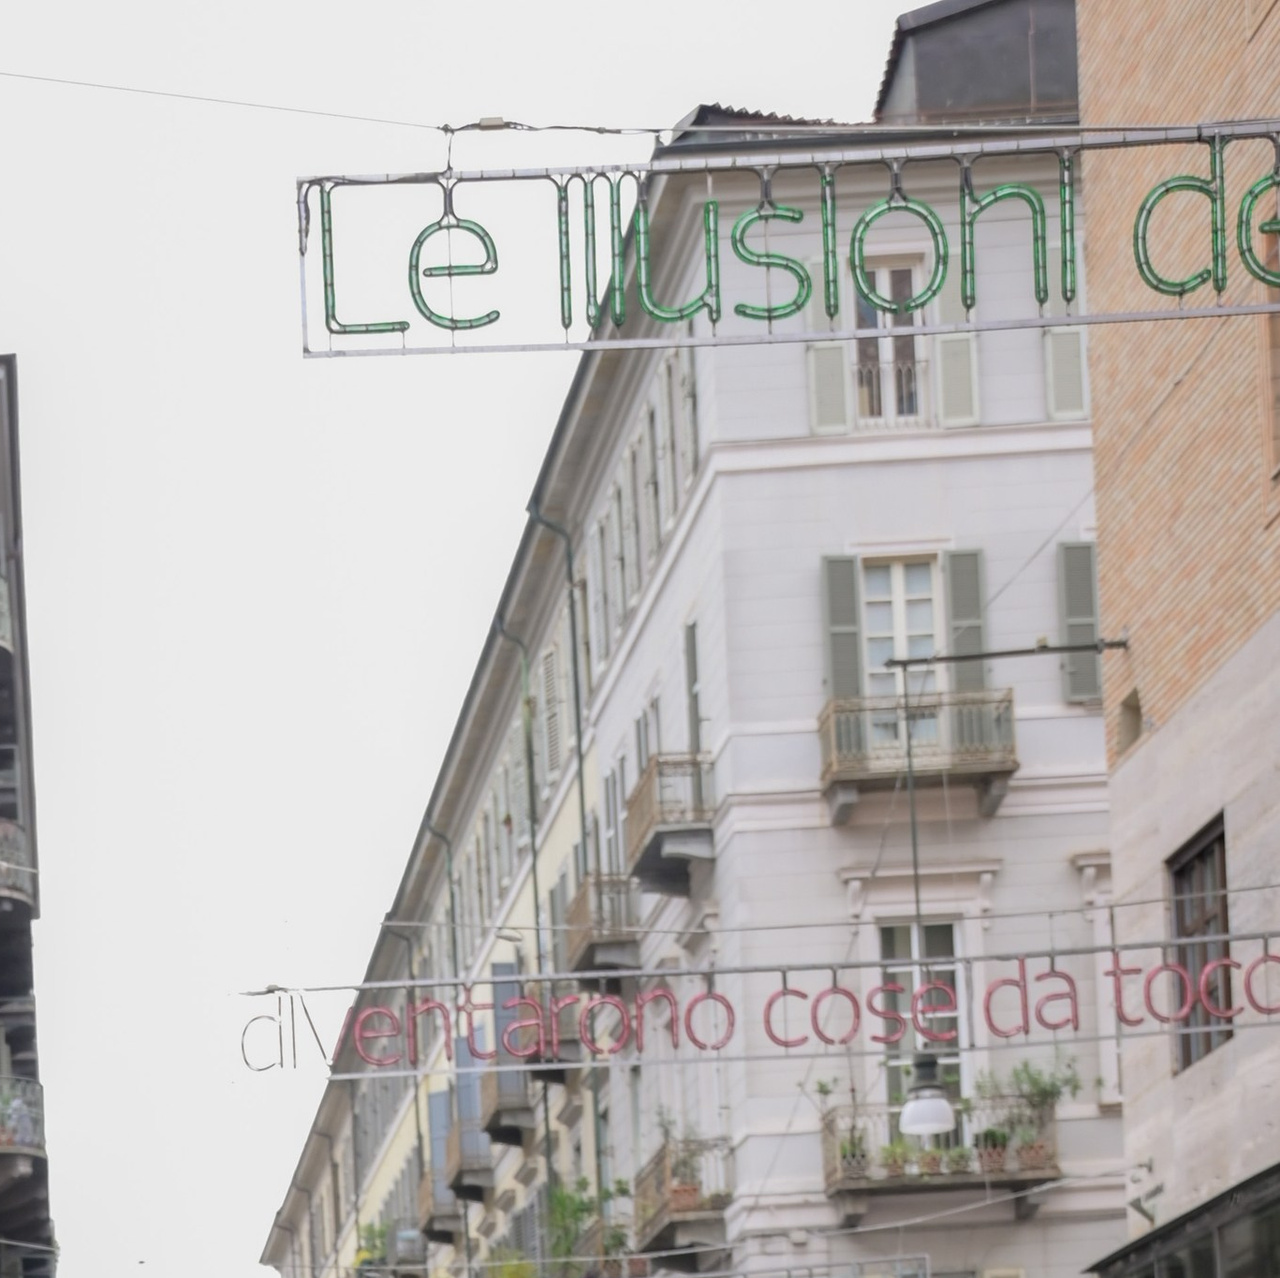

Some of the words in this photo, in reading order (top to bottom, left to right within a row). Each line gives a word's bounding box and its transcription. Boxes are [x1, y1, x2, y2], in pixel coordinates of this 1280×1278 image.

[319, 183, 500, 334] Le
[242, 984, 735, 1071] diventarono
[763, 979, 958, 1048] cose
[983, 954, 1079, 1037] da
